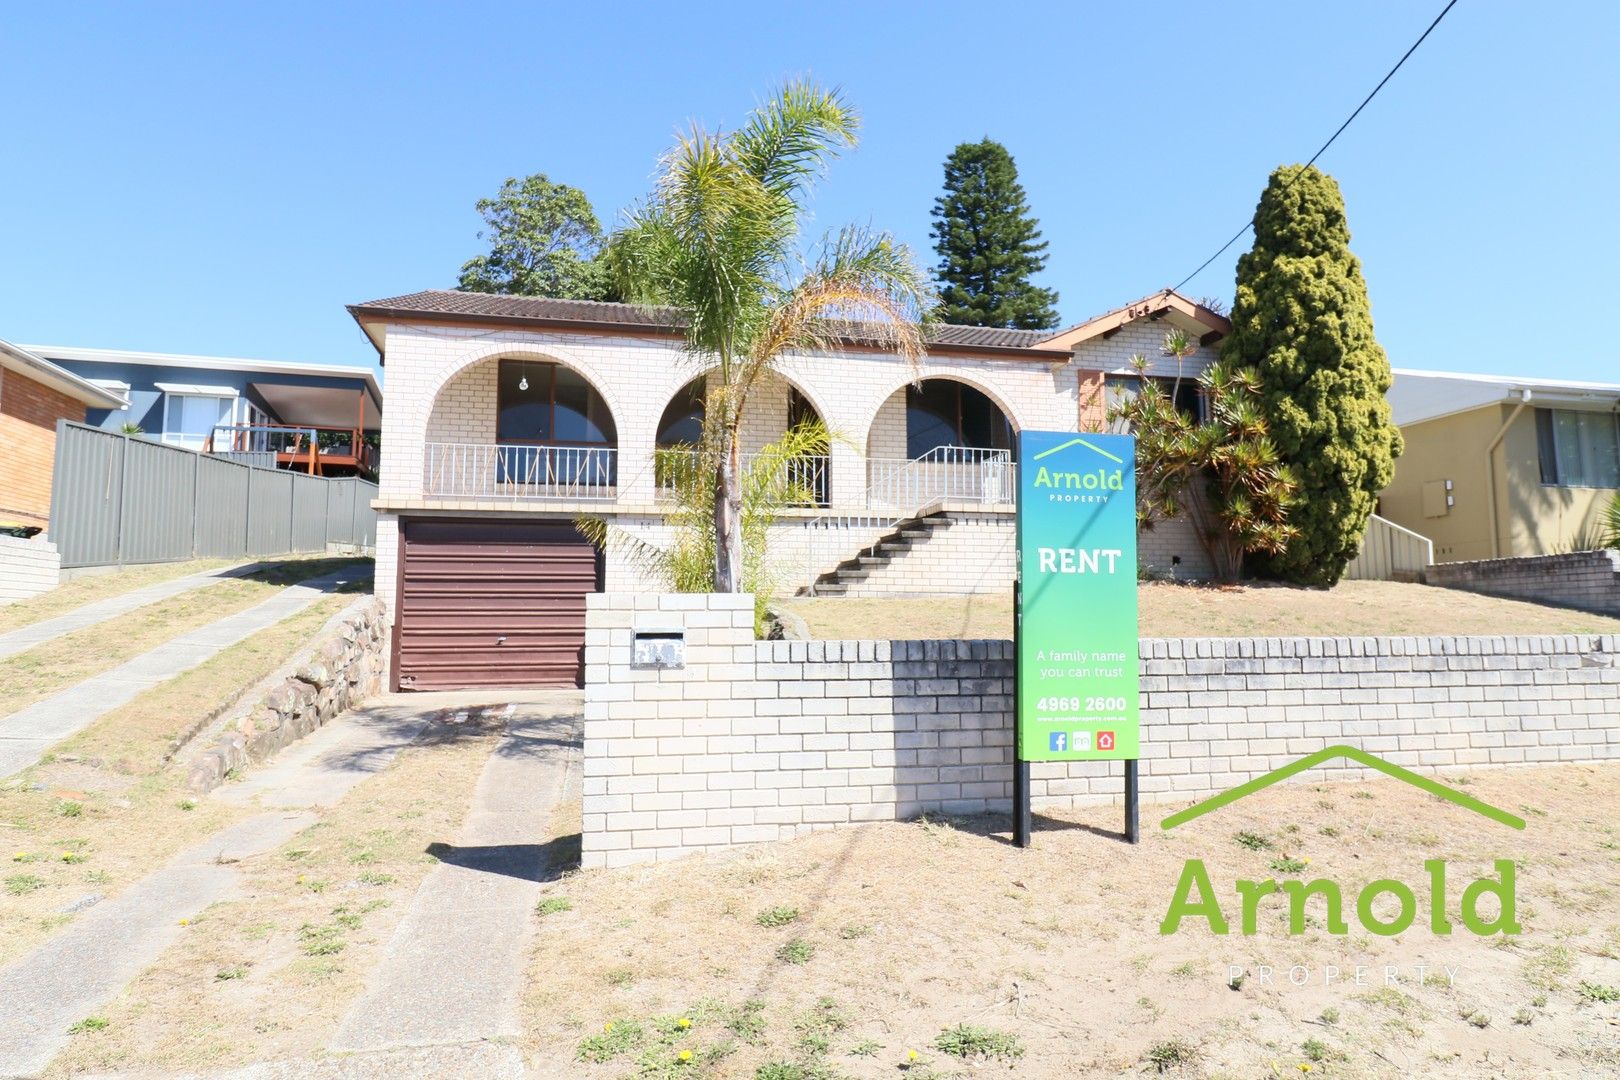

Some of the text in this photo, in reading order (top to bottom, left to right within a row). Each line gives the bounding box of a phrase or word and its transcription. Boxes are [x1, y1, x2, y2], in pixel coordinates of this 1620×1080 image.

[1034, 467, 1124, 490] Arnold
[1050, 494, 1109, 503] PROPERTY
[1038, 547, 1122, 574] RENT
[1037, 649, 1126, 664] A family name
[1040, 666, 1123, 679] you can trust
[1037, 697, 1127, 712] 4969 2600
